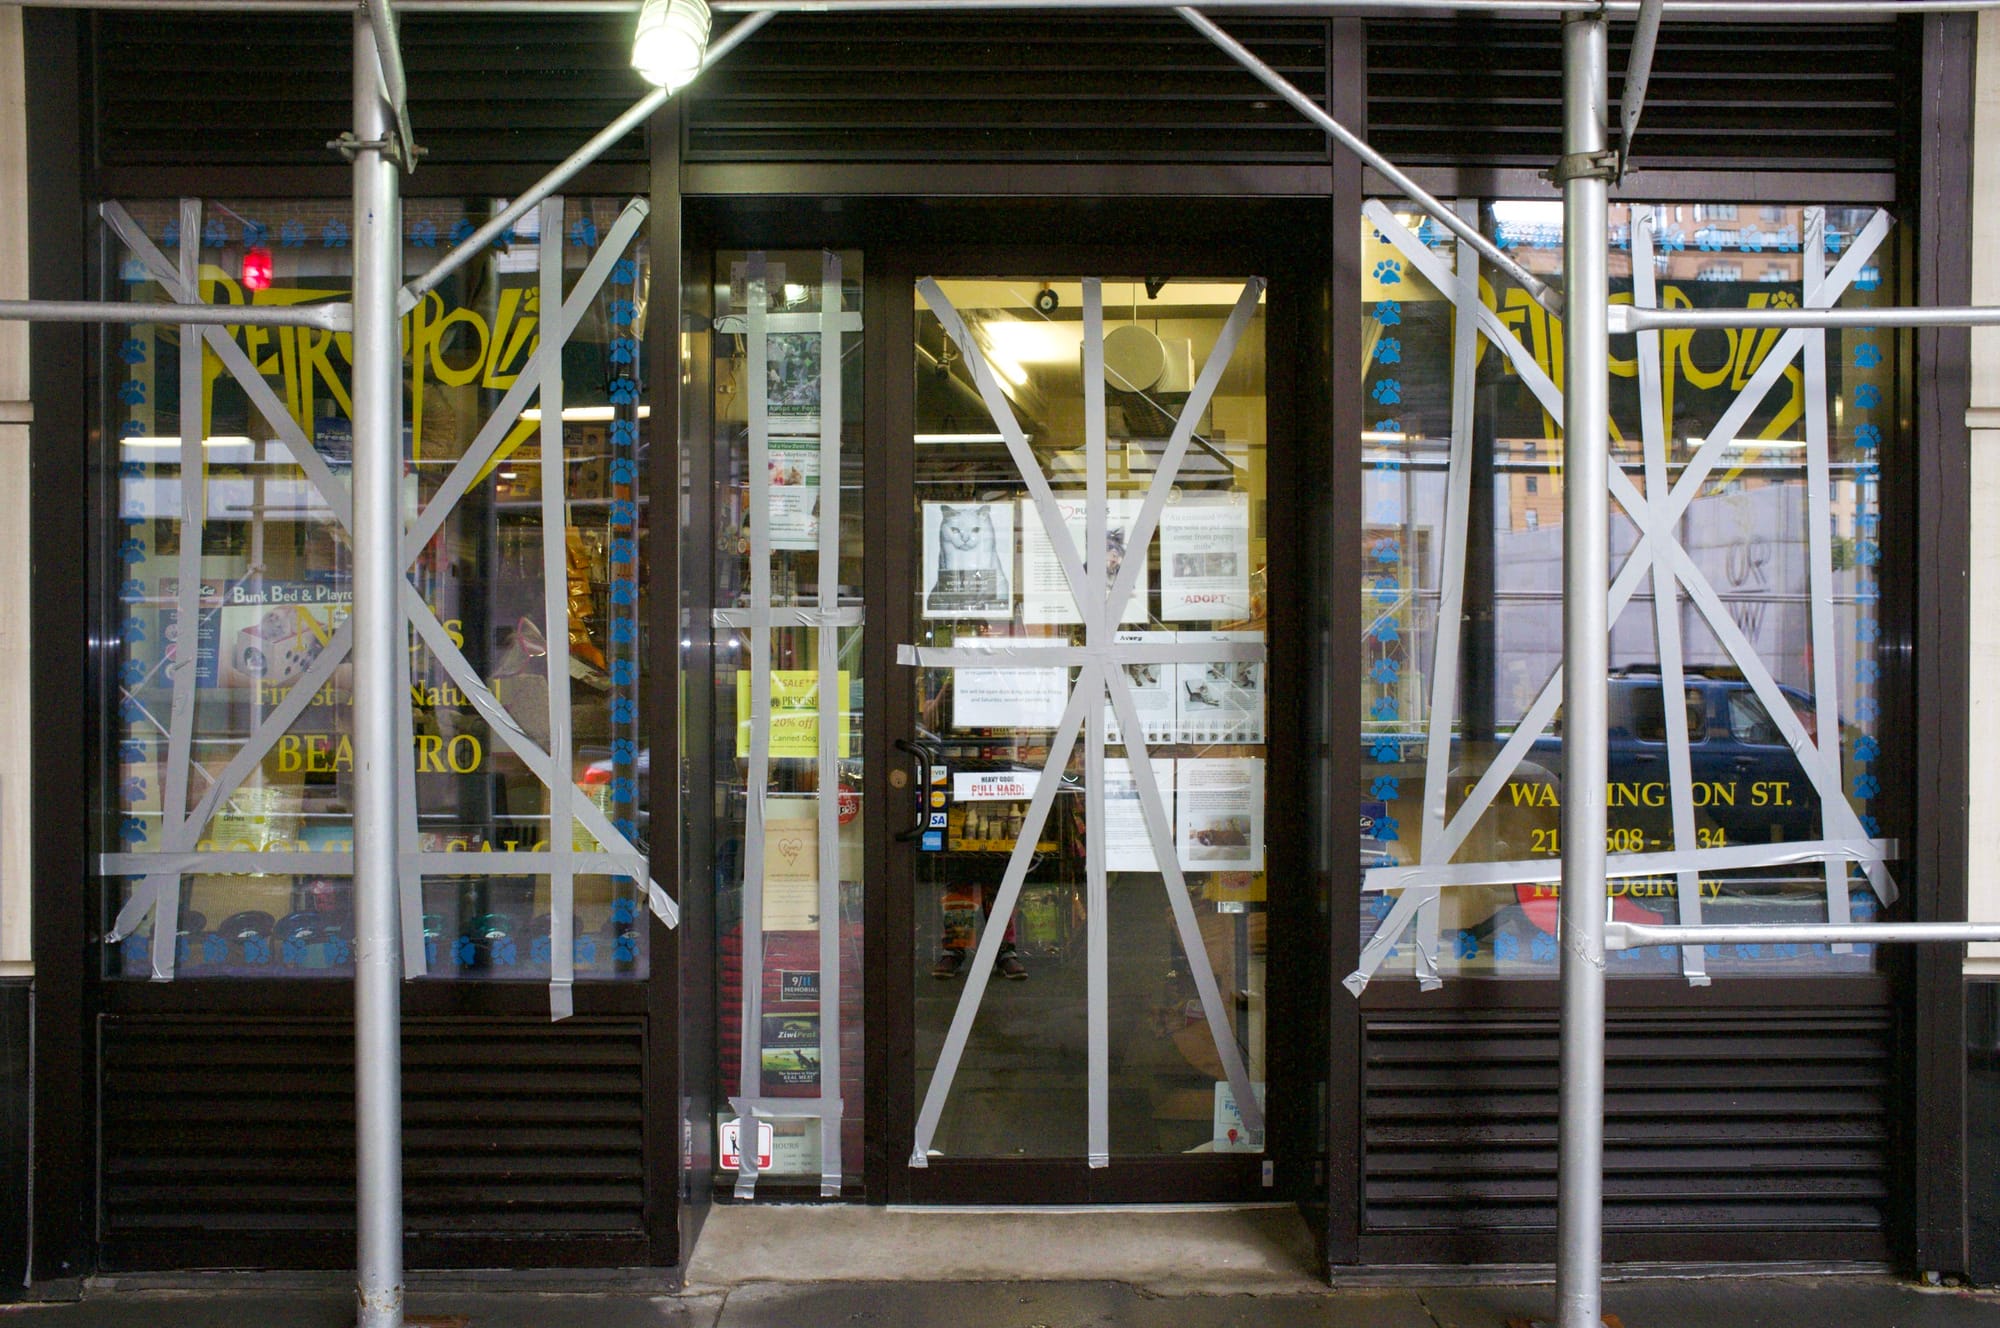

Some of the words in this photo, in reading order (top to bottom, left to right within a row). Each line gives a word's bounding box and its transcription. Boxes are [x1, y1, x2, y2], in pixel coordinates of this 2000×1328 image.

[233, 586, 268, 603] Bunk
[271, 585, 298, 602] Bed
[302, 588, 312, 601] &
[1185, 594, 1226, 603] ADOPT
[797, 718, 815, 730] off
[802, 735, 817, 744] Dog
[277, 734, 483, 774] BEARO
[971, 784, 995, 796] PULL
[1508, 782, 1737, 808] WAINGON
[1751, 781, 1793, 806] ST.
[1606, 874, 1724, 904] Delivry
[792, 975, 812, 987] 9/11
